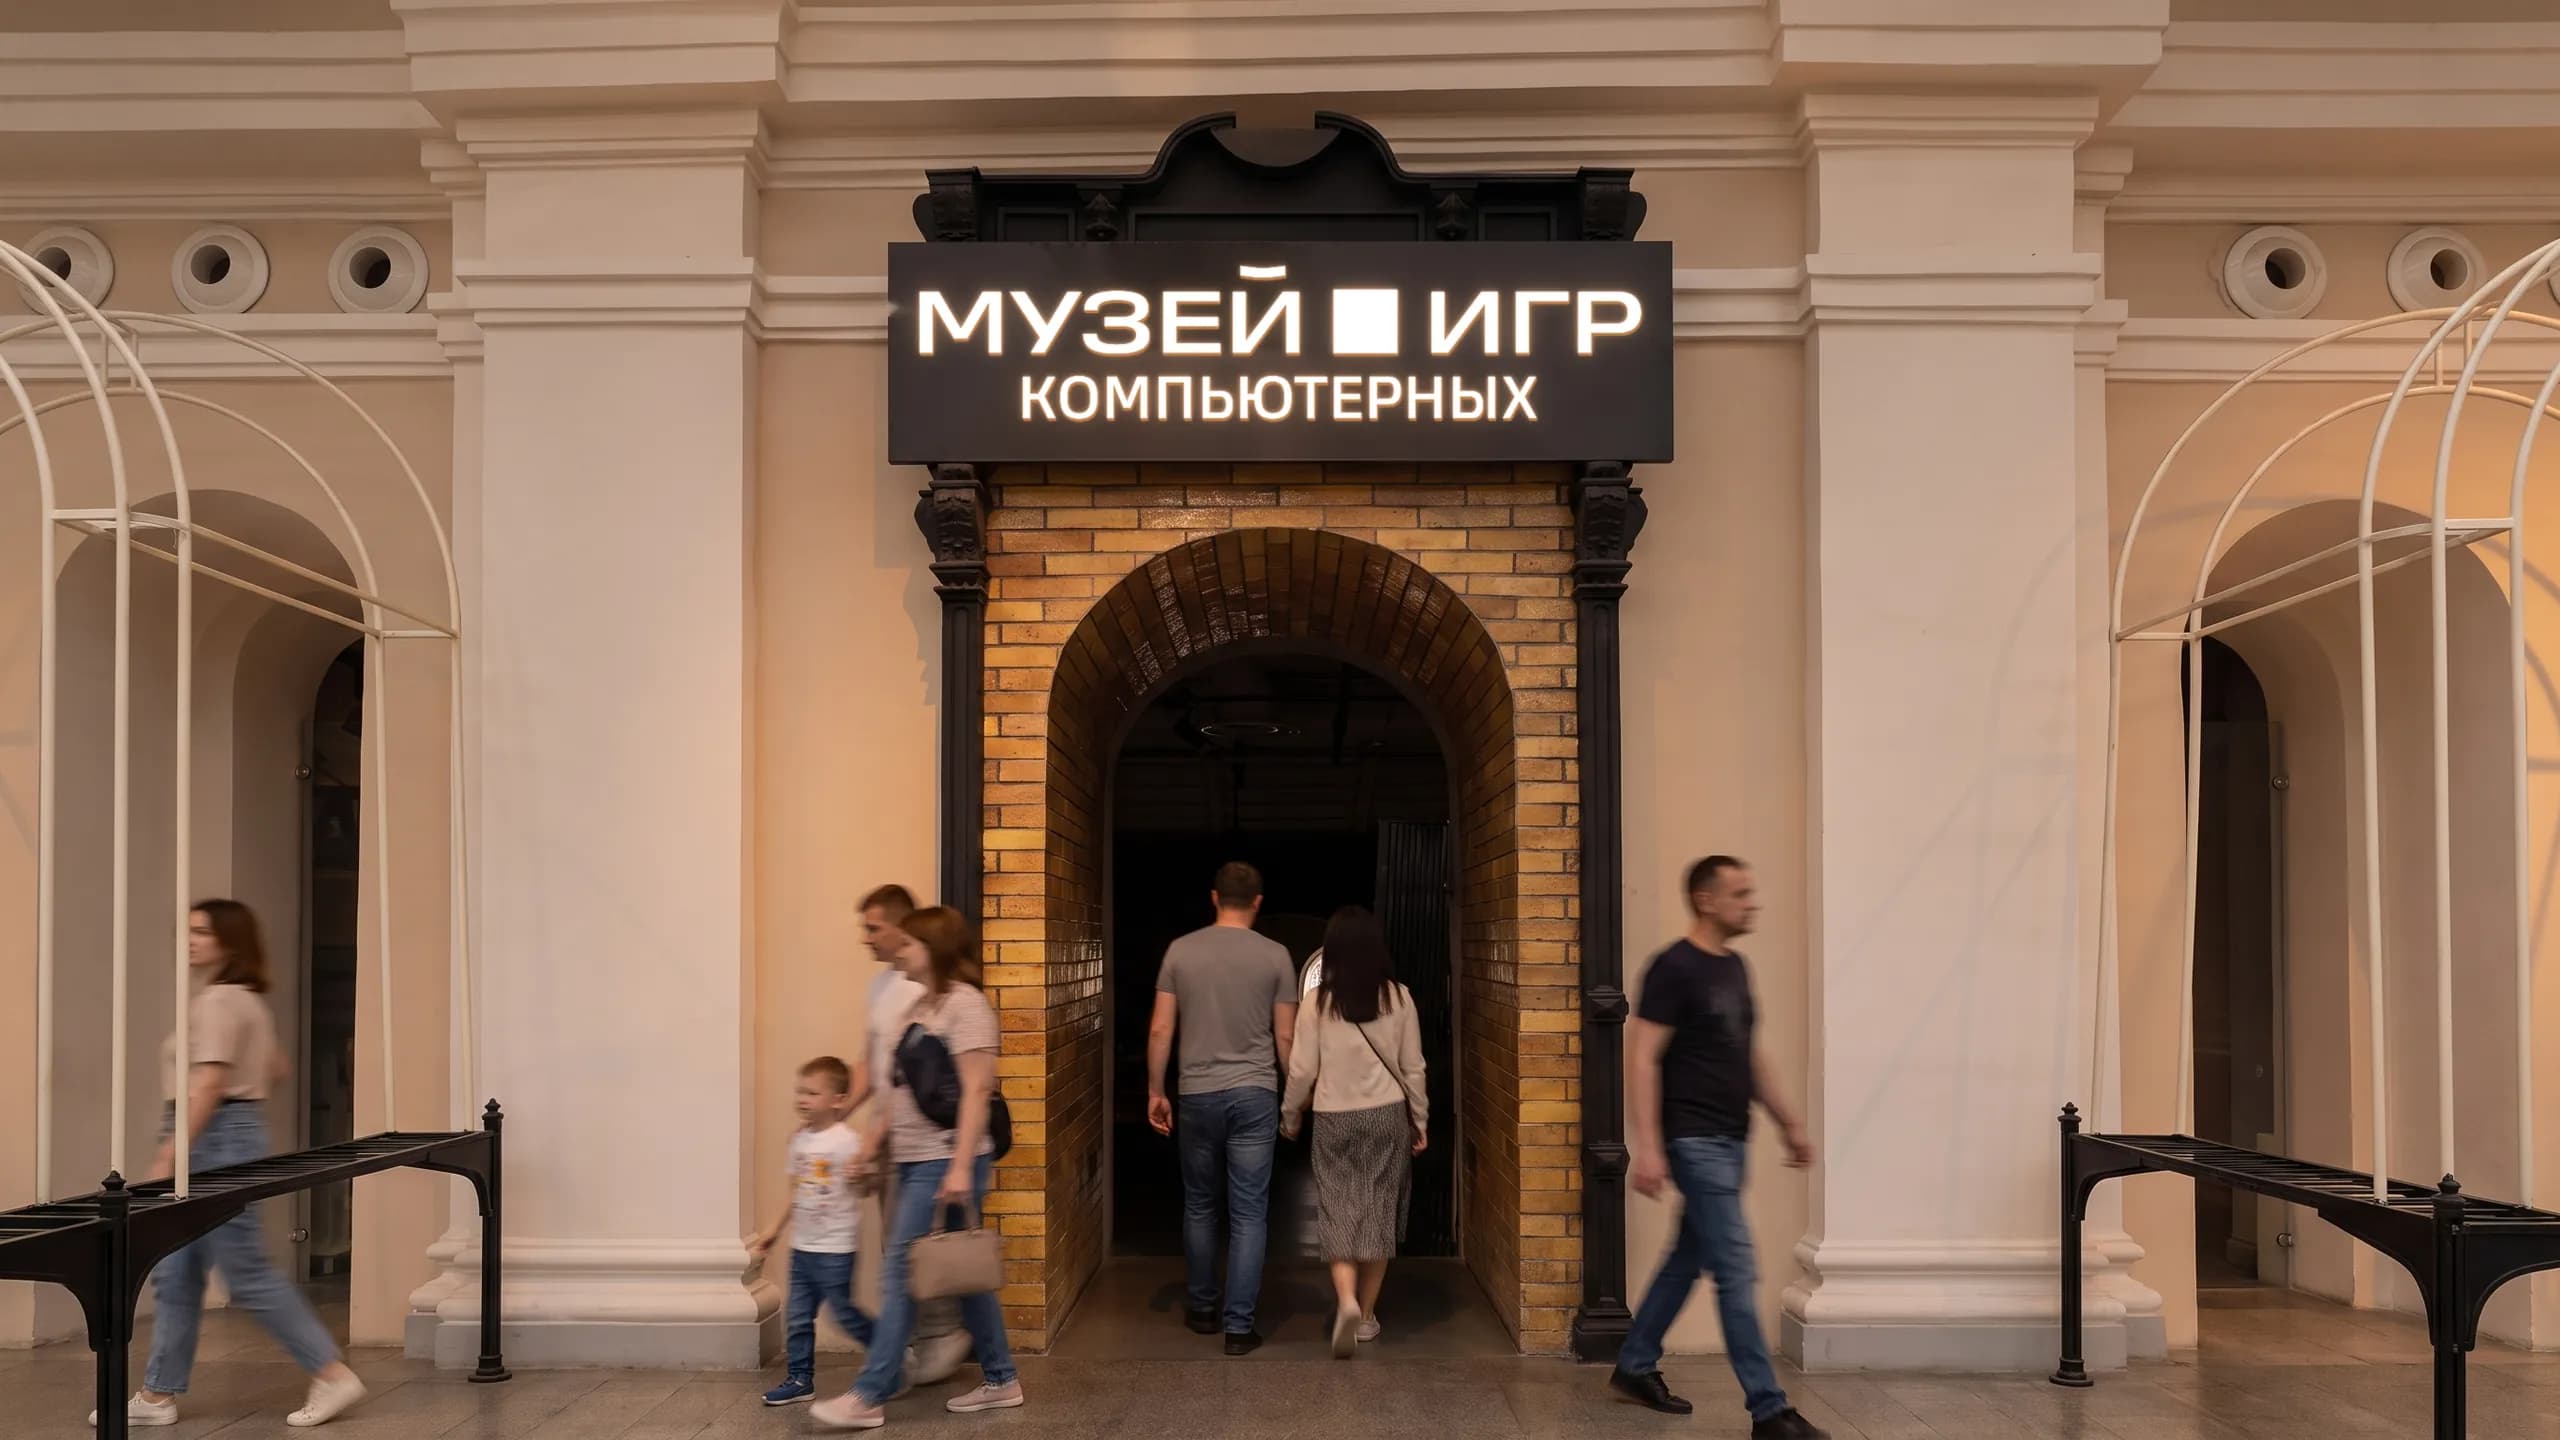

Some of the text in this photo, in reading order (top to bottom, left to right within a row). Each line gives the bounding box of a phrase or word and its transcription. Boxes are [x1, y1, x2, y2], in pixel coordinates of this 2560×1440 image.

[917, 265, 1644, 356] МУЗЕЙ ИГР
[1020, 374, 1538, 421] КОМПЬЮТЕРНЫХ
